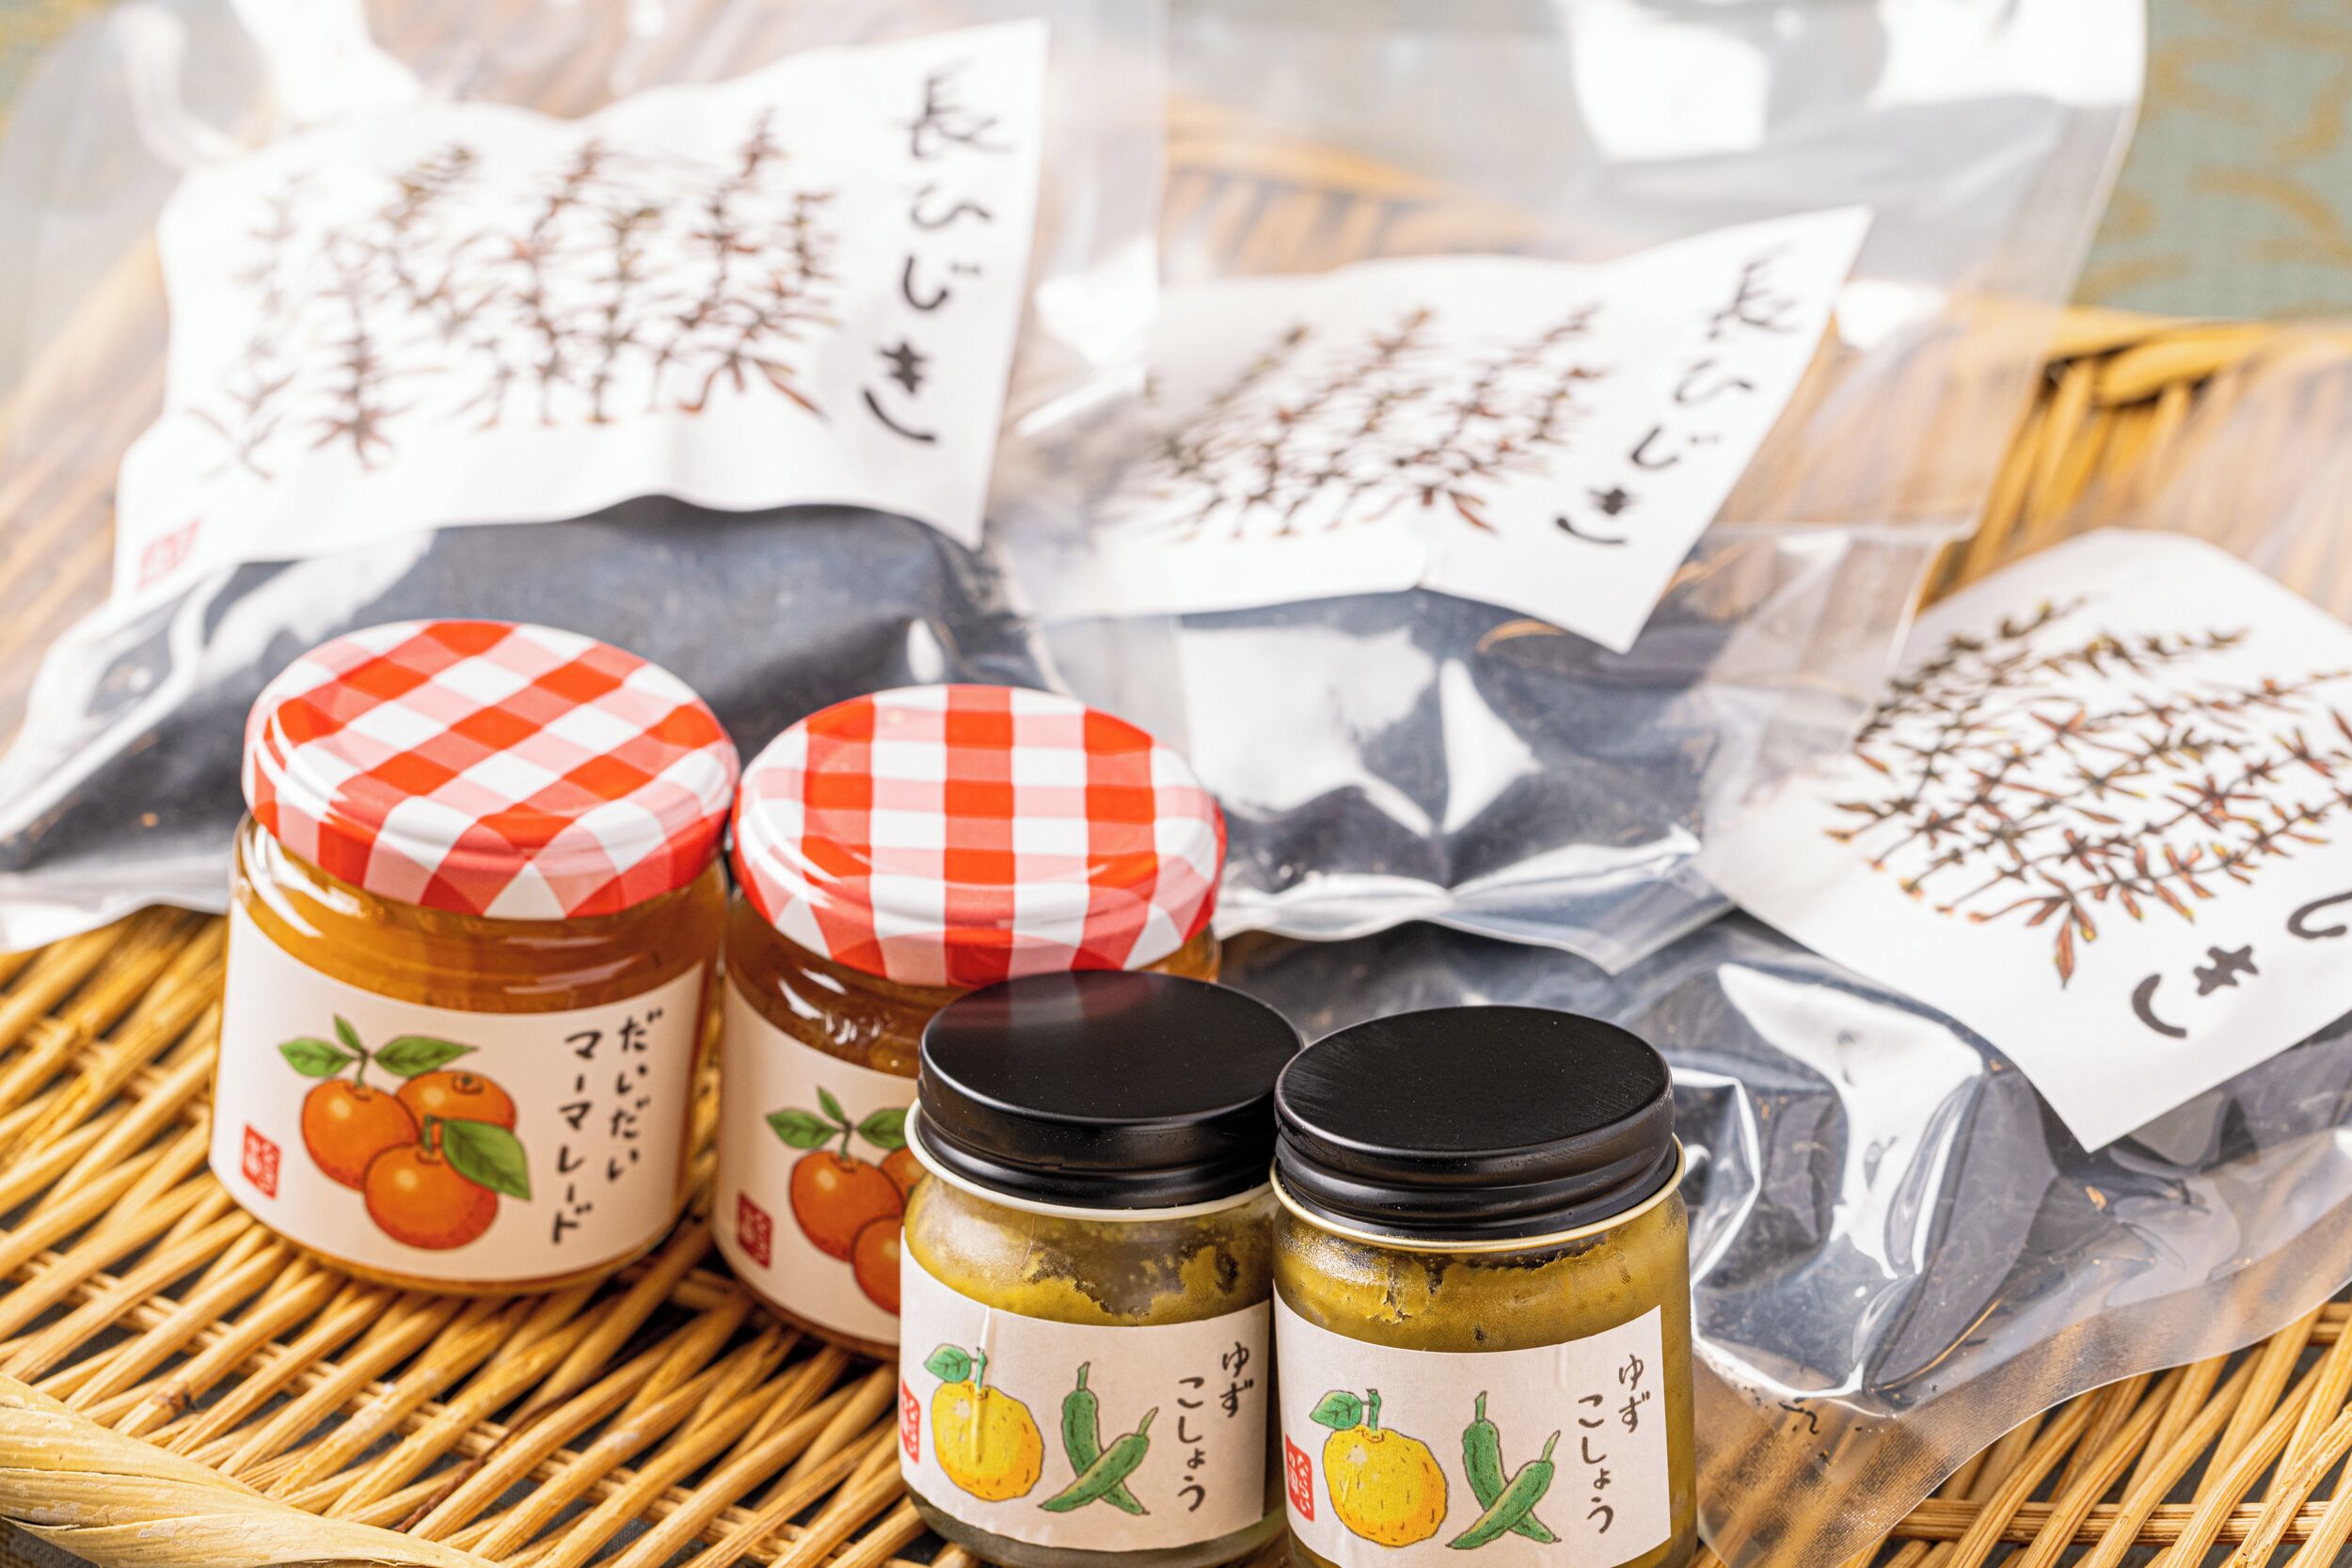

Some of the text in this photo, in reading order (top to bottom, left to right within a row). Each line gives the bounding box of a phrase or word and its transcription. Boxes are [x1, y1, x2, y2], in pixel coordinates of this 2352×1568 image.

[552, 1030, 603, 1243] マーマレード
[607, 1007, 662, 1182] だいだい
[1177, 1376, 1206, 1513] こしょう
[1220, 1341, 1254, 1418] ゆず
[1618, 1354, 1650, 1433] ゆず
[1578, 1394, 1613, 1534] こしょう
